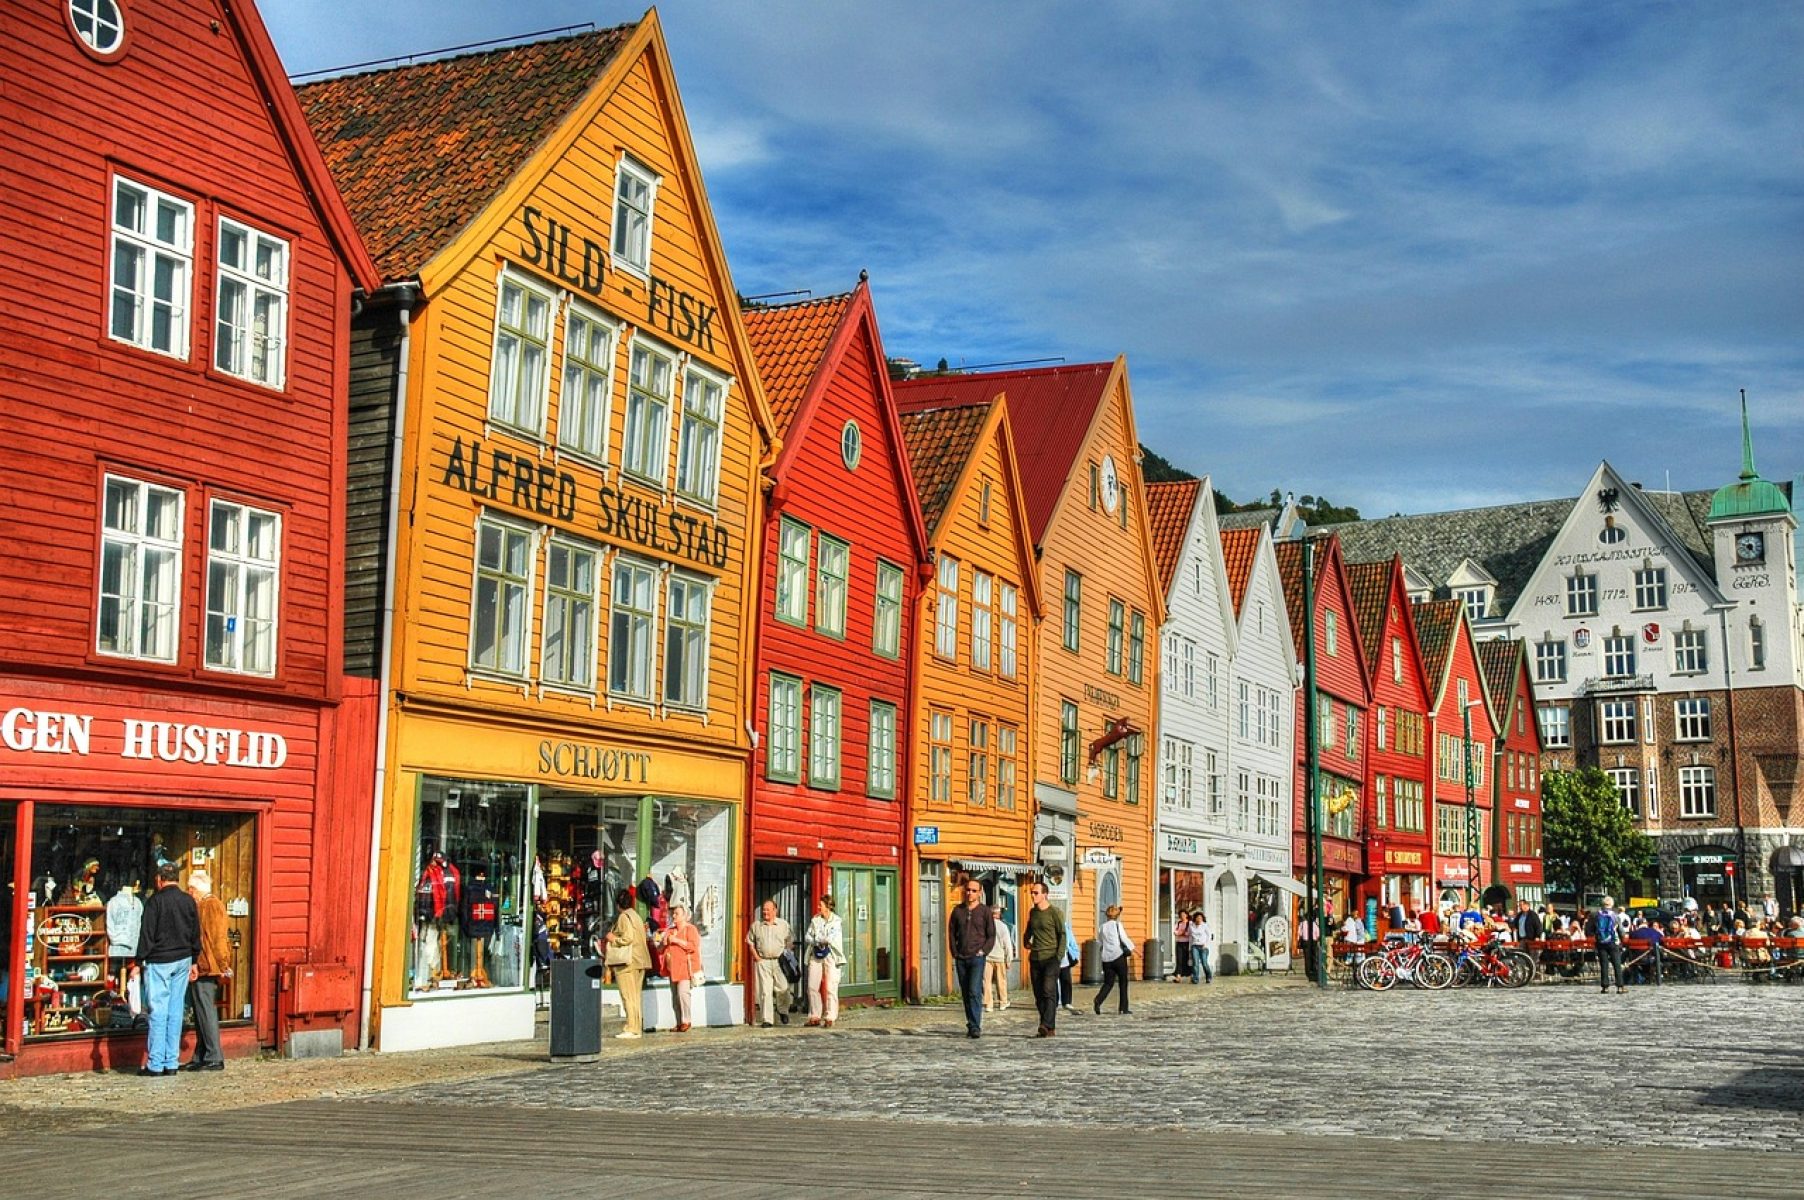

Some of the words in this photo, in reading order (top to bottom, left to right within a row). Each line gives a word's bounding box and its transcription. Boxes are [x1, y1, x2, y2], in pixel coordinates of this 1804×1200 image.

[519, 206, 606, 297] SILD
[644, 275, 718, 353] FISK
[443, 435, 577, 522] ALFRED
[598, 486, 728, 569] SKULSTAD
[0, 707, 93, 755] GEN
[121, 718, 288, 769] HUSFLID
[538, 739, 651, 783] SCHJØTT
